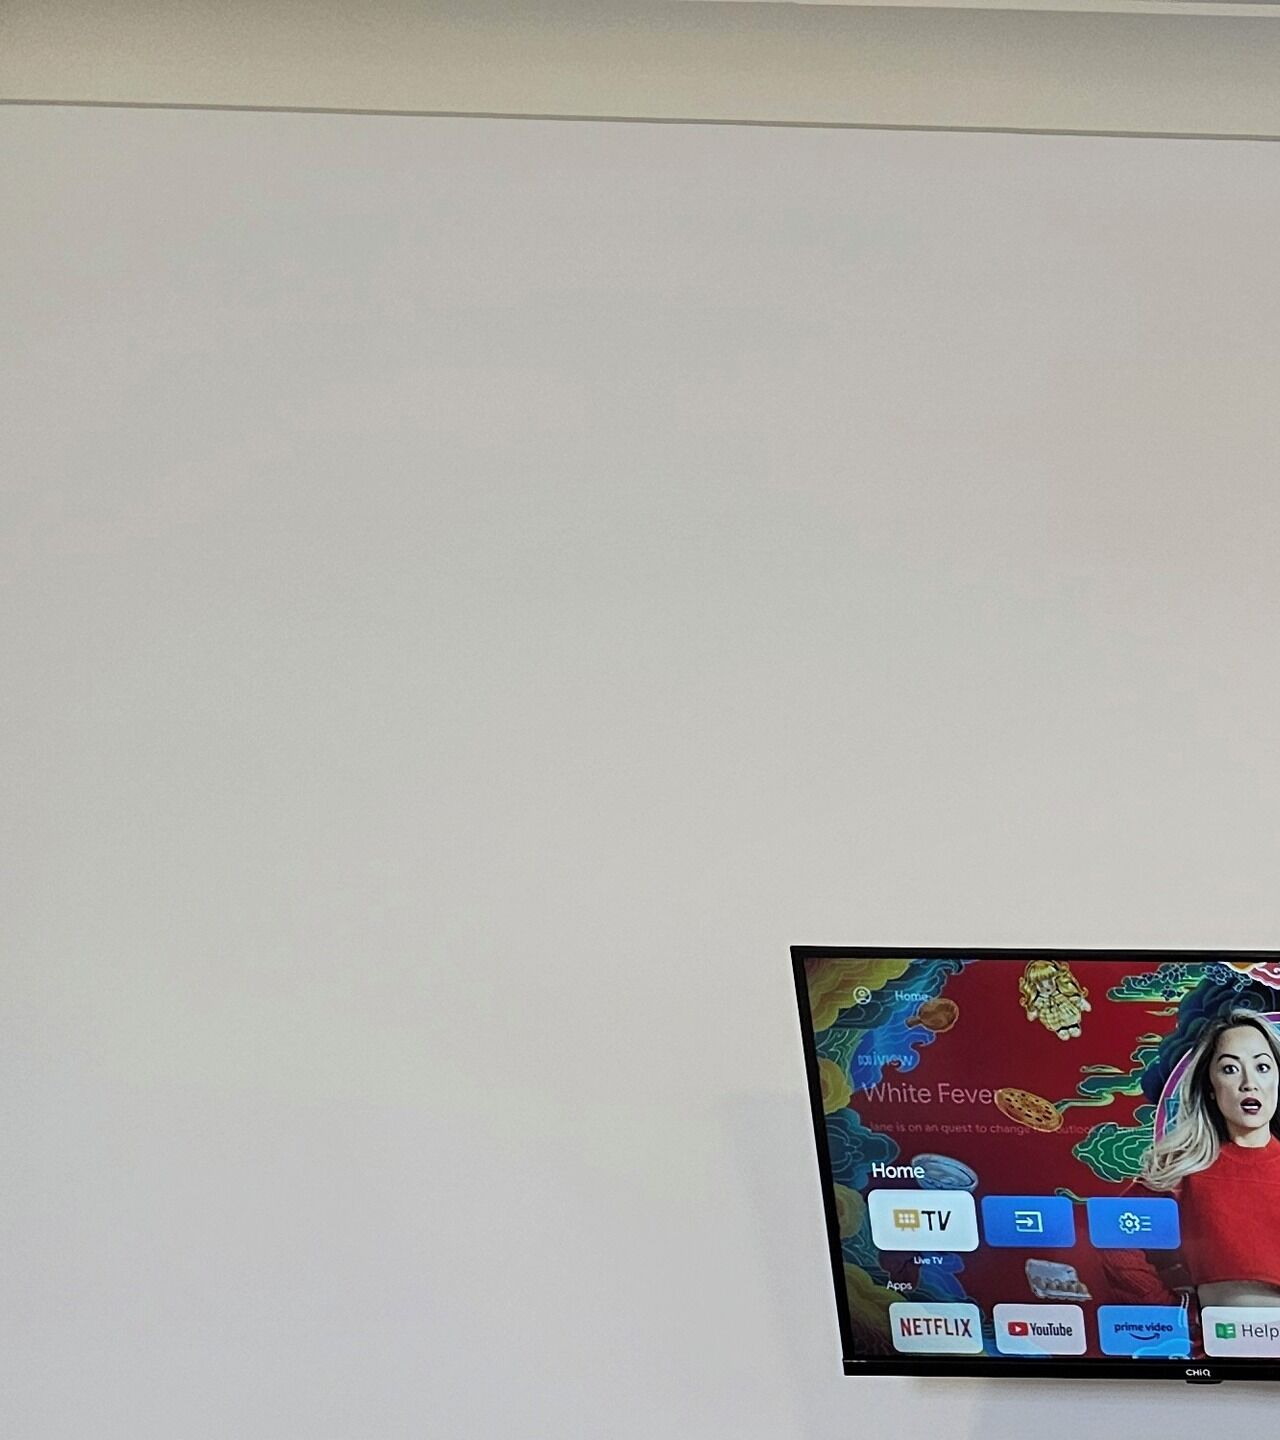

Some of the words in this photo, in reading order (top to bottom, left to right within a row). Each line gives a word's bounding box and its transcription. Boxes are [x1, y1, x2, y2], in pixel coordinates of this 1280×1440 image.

[894, 990, 929, 1001] Home
[861, 1082, 932, 1104] White
[896, 1121, 906, 1132] is
[908, 1123, 922, 1132] on
[941, 1123, 972, 1135] quest
[975, 1123, 987, 1133] to
[990, 1123, 1030, 1137] change
[872, 1162, 925, 1179] Home
[921, 1210, 952, 1231] TV
[913, 1256, 931, 1265] Live
[932, 1256, 944, 1265] TV
[886, 1280, 913, 1291] Apps
[900, 1317, 973, 1338] NETFLIX
[1030, 1322, 1073, 1337] YouTube
[1114, 1323, 1144, 1333] prime
[1146, 1322, 1174, 1332] video
[1241, 1324, 1280, 1341] Help
